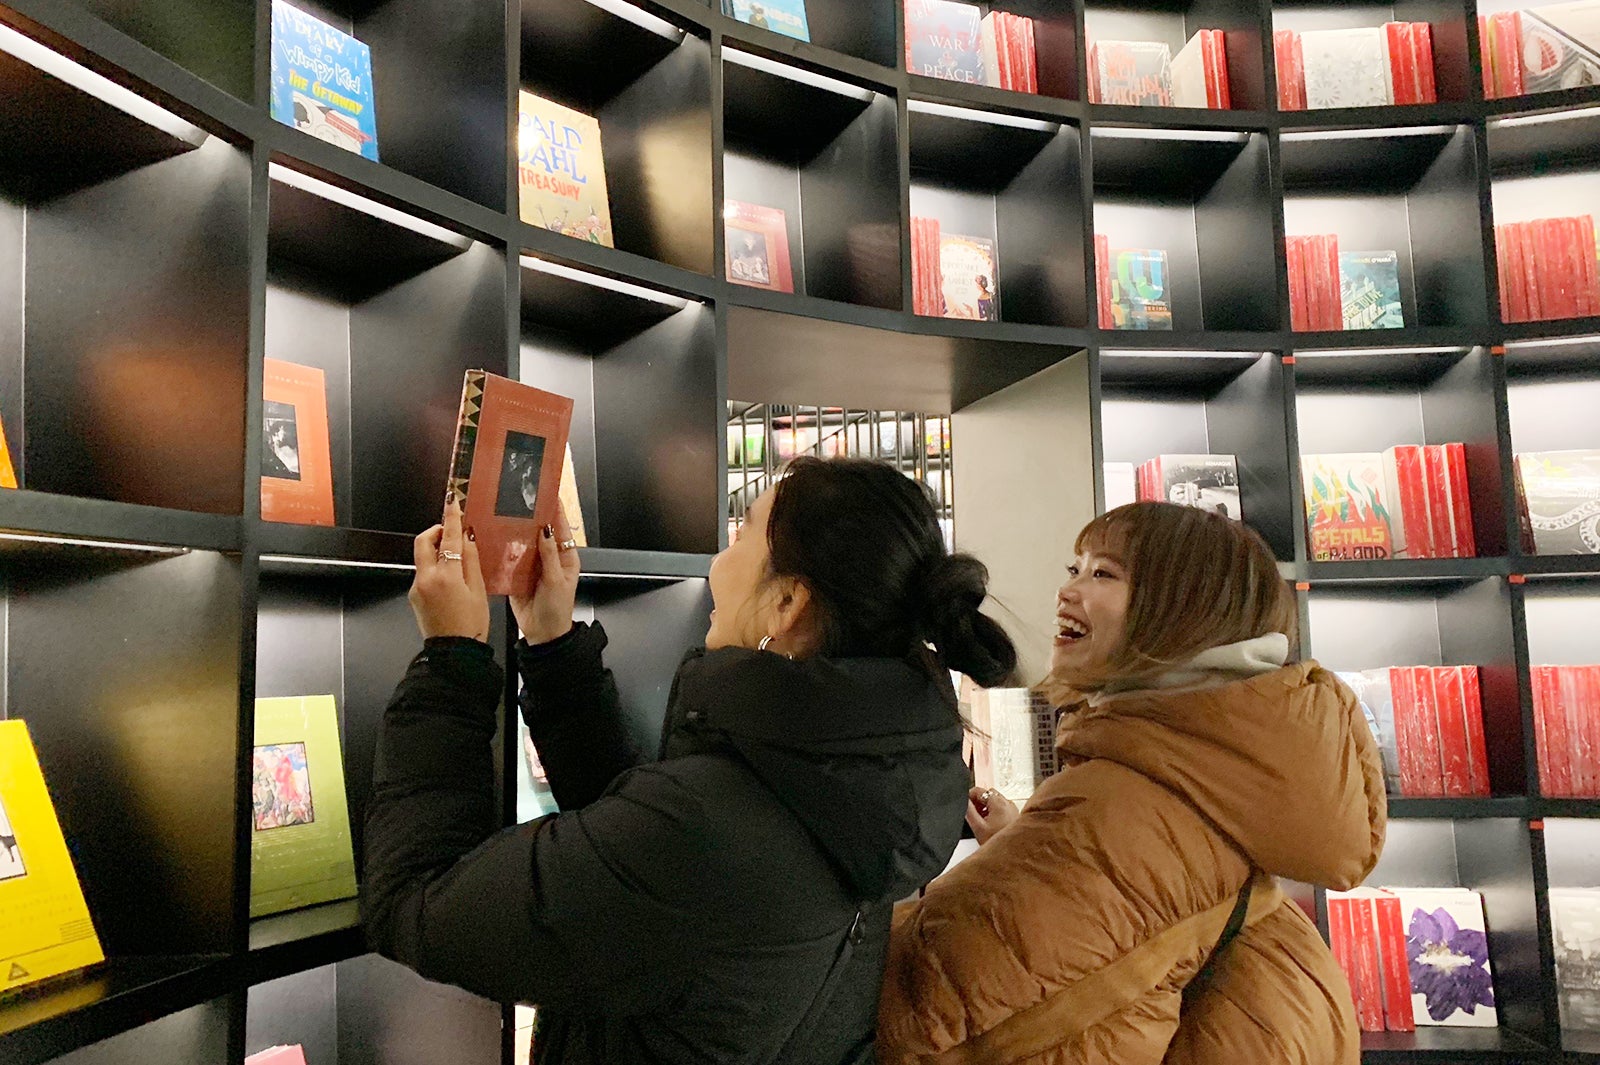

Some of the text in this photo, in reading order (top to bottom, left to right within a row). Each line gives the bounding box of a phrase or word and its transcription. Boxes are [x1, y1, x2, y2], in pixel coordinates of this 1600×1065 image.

[928, 33, 965, 53] WAR
[279, 38, 361, 95] Wimpy Kid
[288, 67, 309, 92] THE
[923, 62, 977, 84] PEACE
[519, 110, 583, 151] OALD
[519, 144, 587, 184] AHL
[519, 166, 581, 202] TREASURY
[1314, 525, 1386, 547] PETALS
